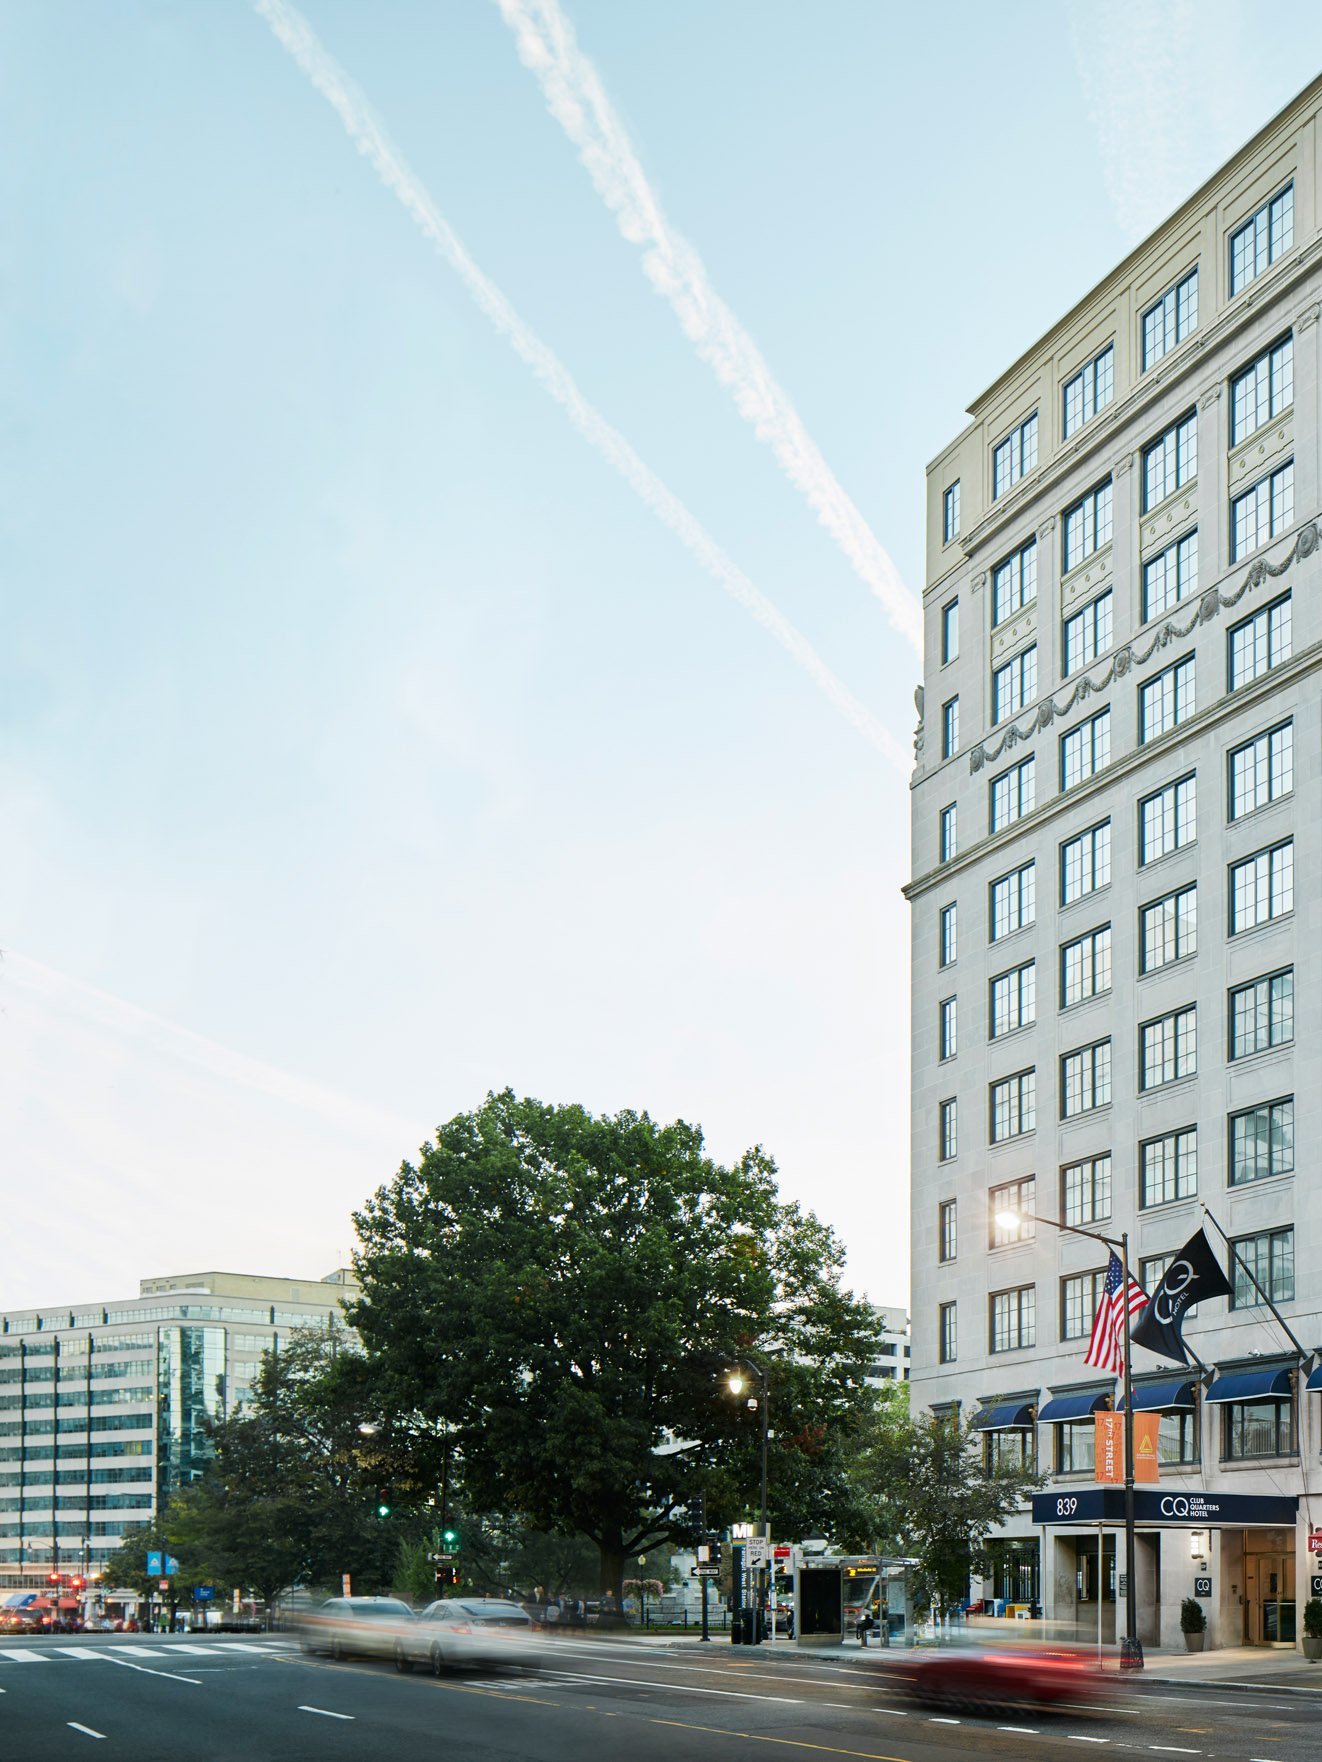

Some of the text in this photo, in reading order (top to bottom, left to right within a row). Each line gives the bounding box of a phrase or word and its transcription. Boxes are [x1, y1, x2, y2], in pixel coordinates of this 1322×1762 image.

[1154, 1260, 1200, 1325] CQ
[1172, 1291, 1190, 1316] HOTEL
[1105, 1440, 1114, 1478] STREET
[1056, 1498, 1078, 1516] 839
[1160, 1496, 1189, 1517] CQ
[1197, 1579, 1210, 1591] CQ
